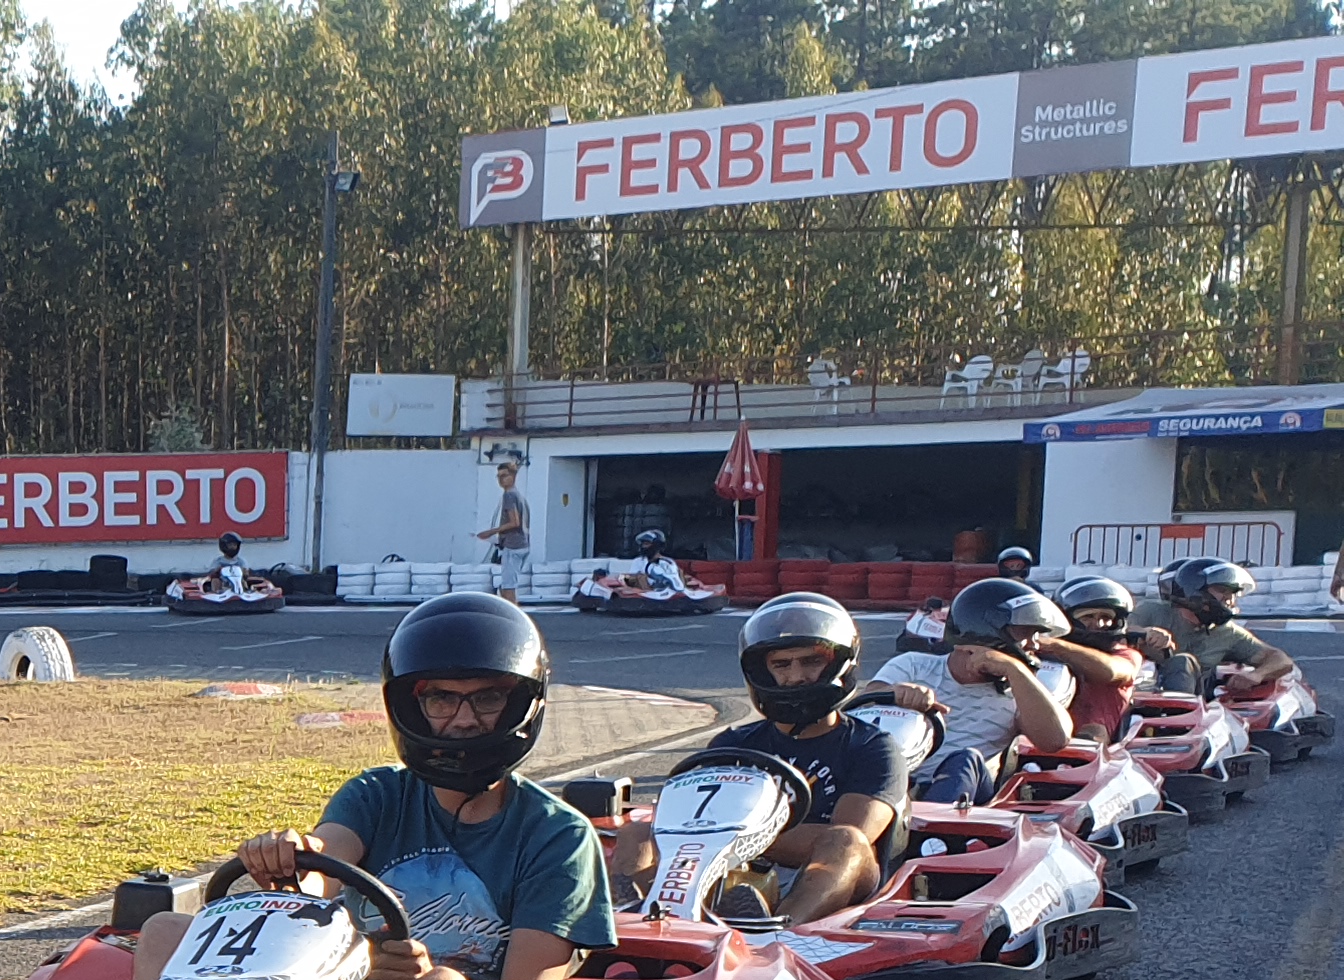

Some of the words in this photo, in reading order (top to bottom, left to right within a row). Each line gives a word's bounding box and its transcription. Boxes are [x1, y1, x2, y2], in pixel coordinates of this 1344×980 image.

[1035, 98, 1116, 124] Metallic
[1020, 117, 1128, 143] Structures
[574, 98, 979, 202] FERBERTO
[1158, 415, 1262, 432] SEGURANÇA
[673, 774, 755, 789] EUROINDY
[693, 784, 721, 819] 7
[203, 900, 303, 918] EUROIND
[188, 915, 269, 965] 14
